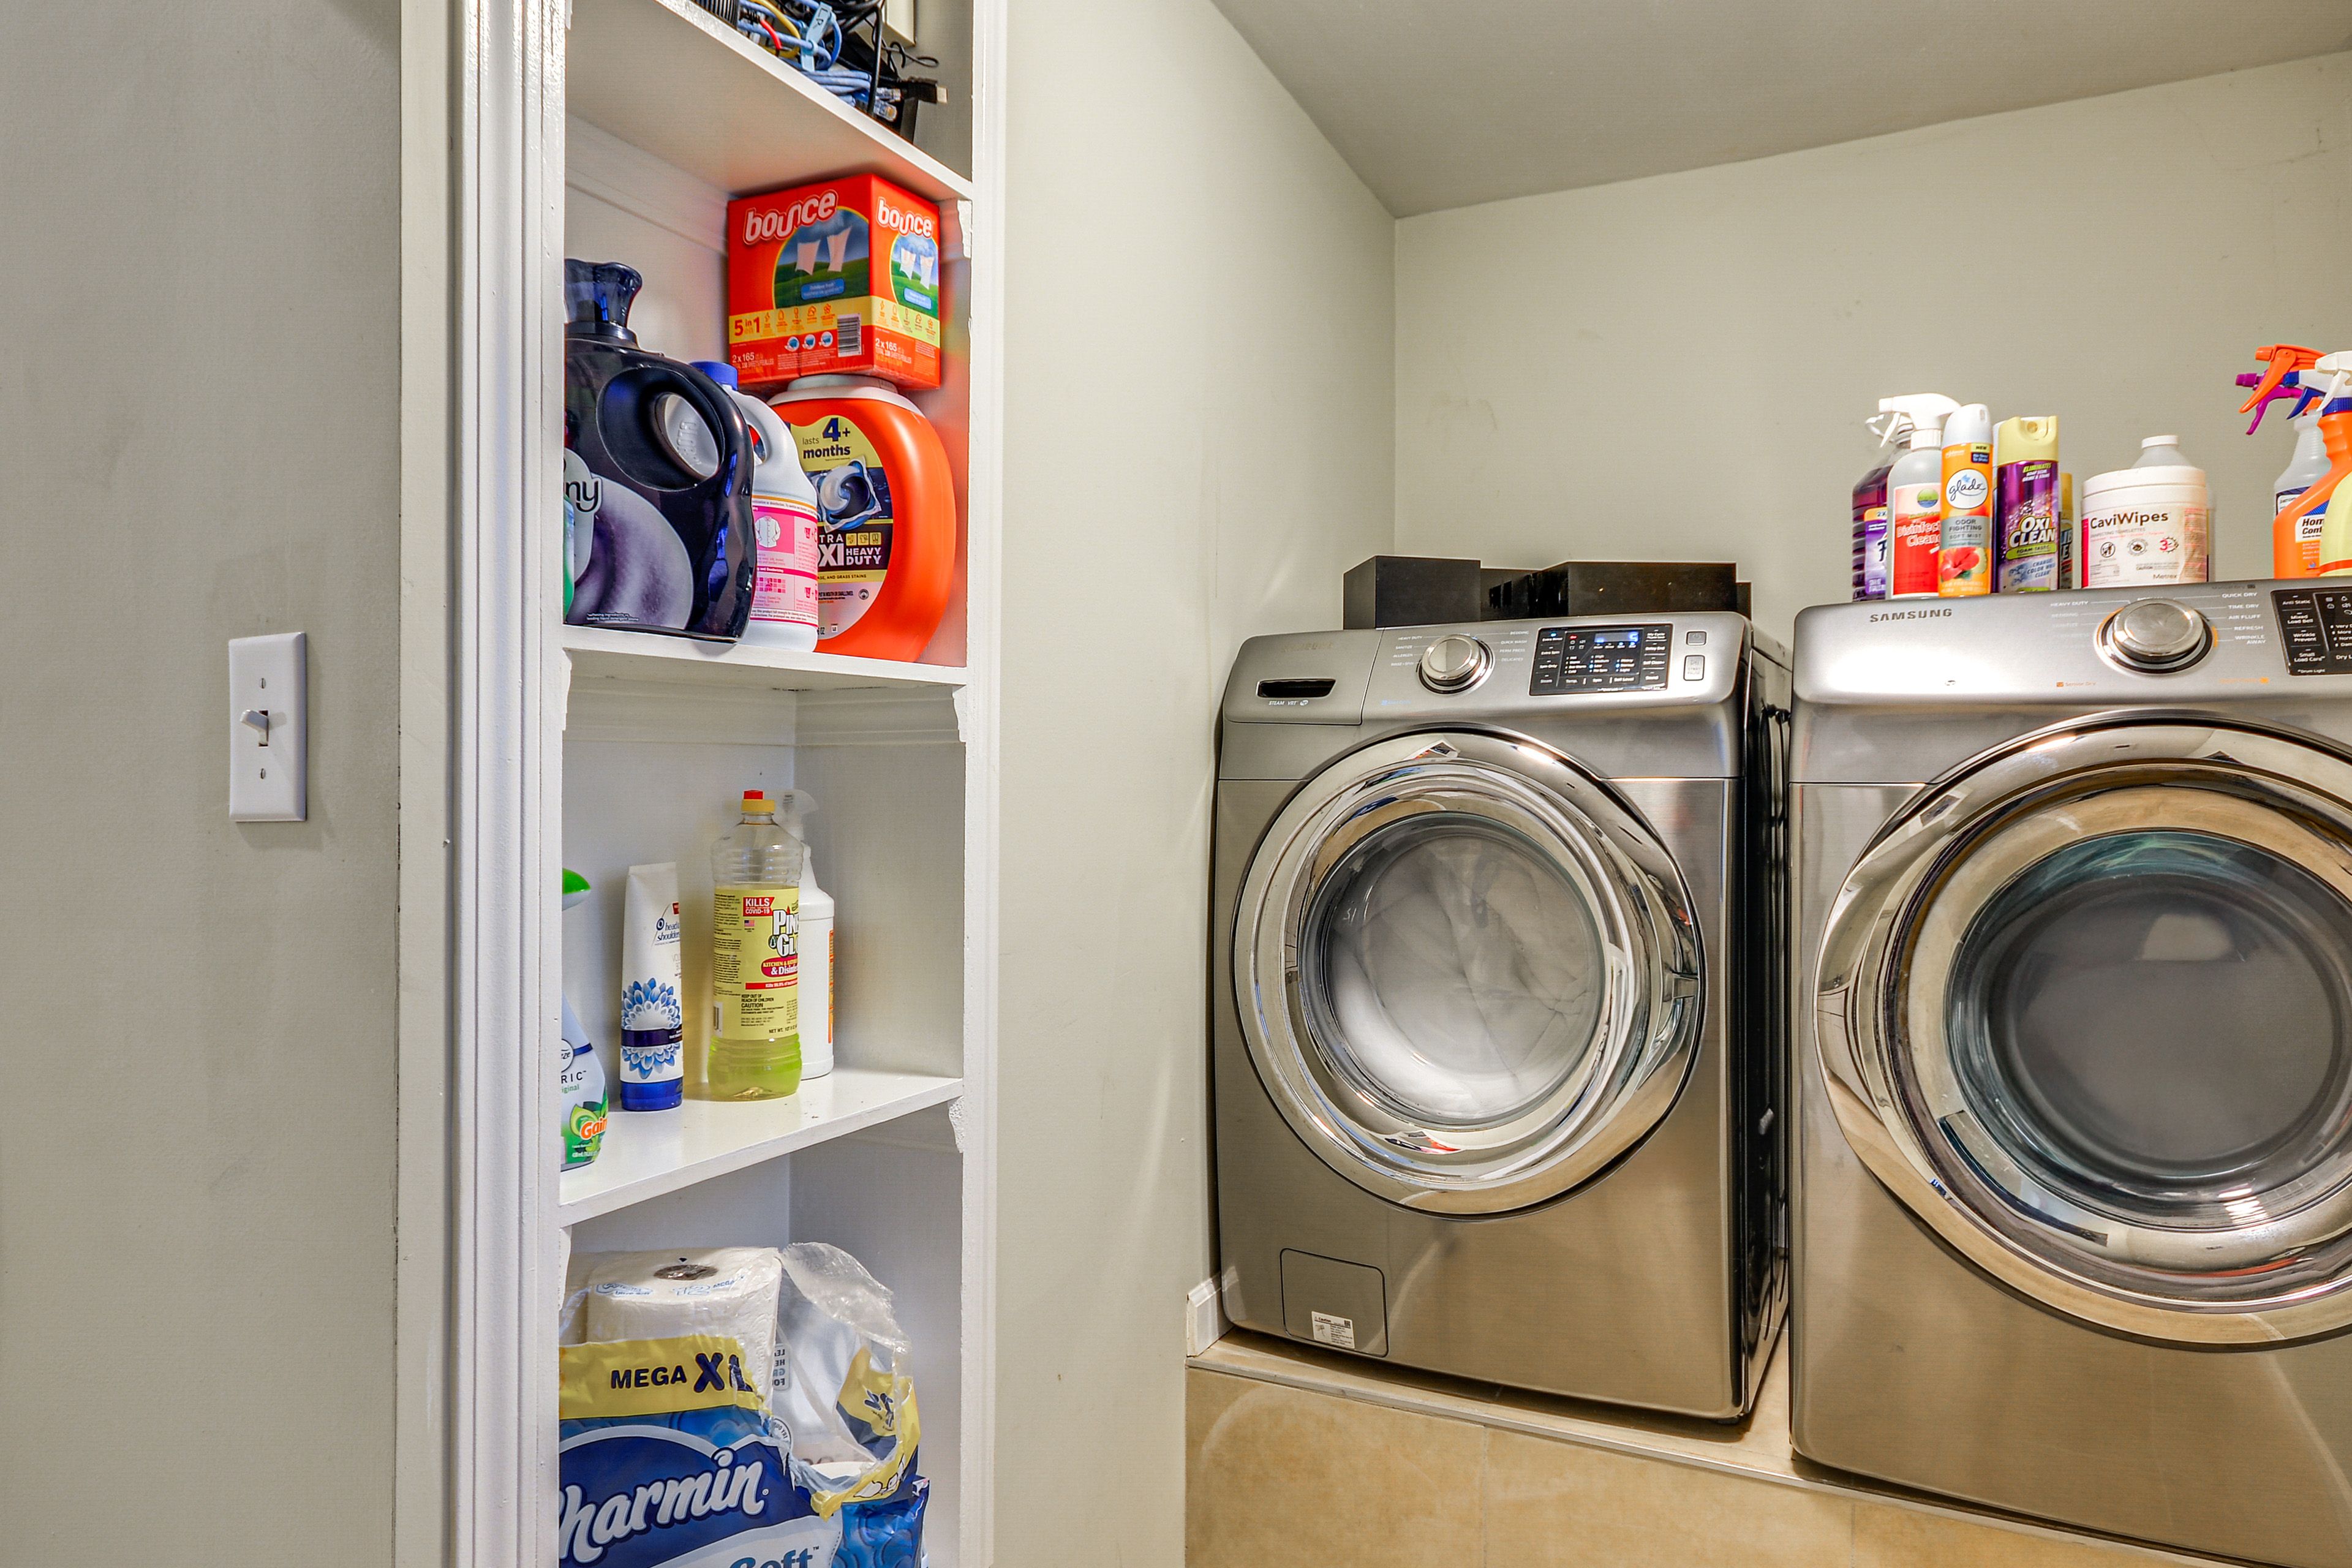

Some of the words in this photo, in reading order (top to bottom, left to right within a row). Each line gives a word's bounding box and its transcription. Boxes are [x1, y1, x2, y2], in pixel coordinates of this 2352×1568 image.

[745, 190, 837, 243] bounce
[877, 197, 932, 238] bounce
[735, 319, 744, 336] 5
[753, 316, 760, 333] 1
[875, 337, 880, 347] 2
[886, 341, 897, 352] 165
[732, 354, 737, 364] 2
[742, 352, 755, 361] 165
[823, 417, 851, 442] 4+
[803, 444, 851, 459] months
[1948, 478, 1986, 501] glade
[2021, 517, 2050, 532] OXI
[2090, 511, 2169, 529] CaviWipes
[2010, 528, 2056, 548] CLEAN
[2159, 538, 2168, 551] 3
[818, 543, 844, 567] XI
[846, 547, 881, 556] HEAVY
[846, 555, 882, 566] DUTY
[2027, 566, 2044, 575] COLOR
[1870, 608, 1953, 622] SAMSUNG
[745, 898, 770, 907] KILLS
[771, 967, 778, 975] &
[561, 1072, 583, 1084] RIC
[562, 1084, 579, 1094] iginal
[581, 1117, 607, 1139] Gain
[611, 1364, 688, 1390] MEGA
[693, 1352, 754, 1393] XL
